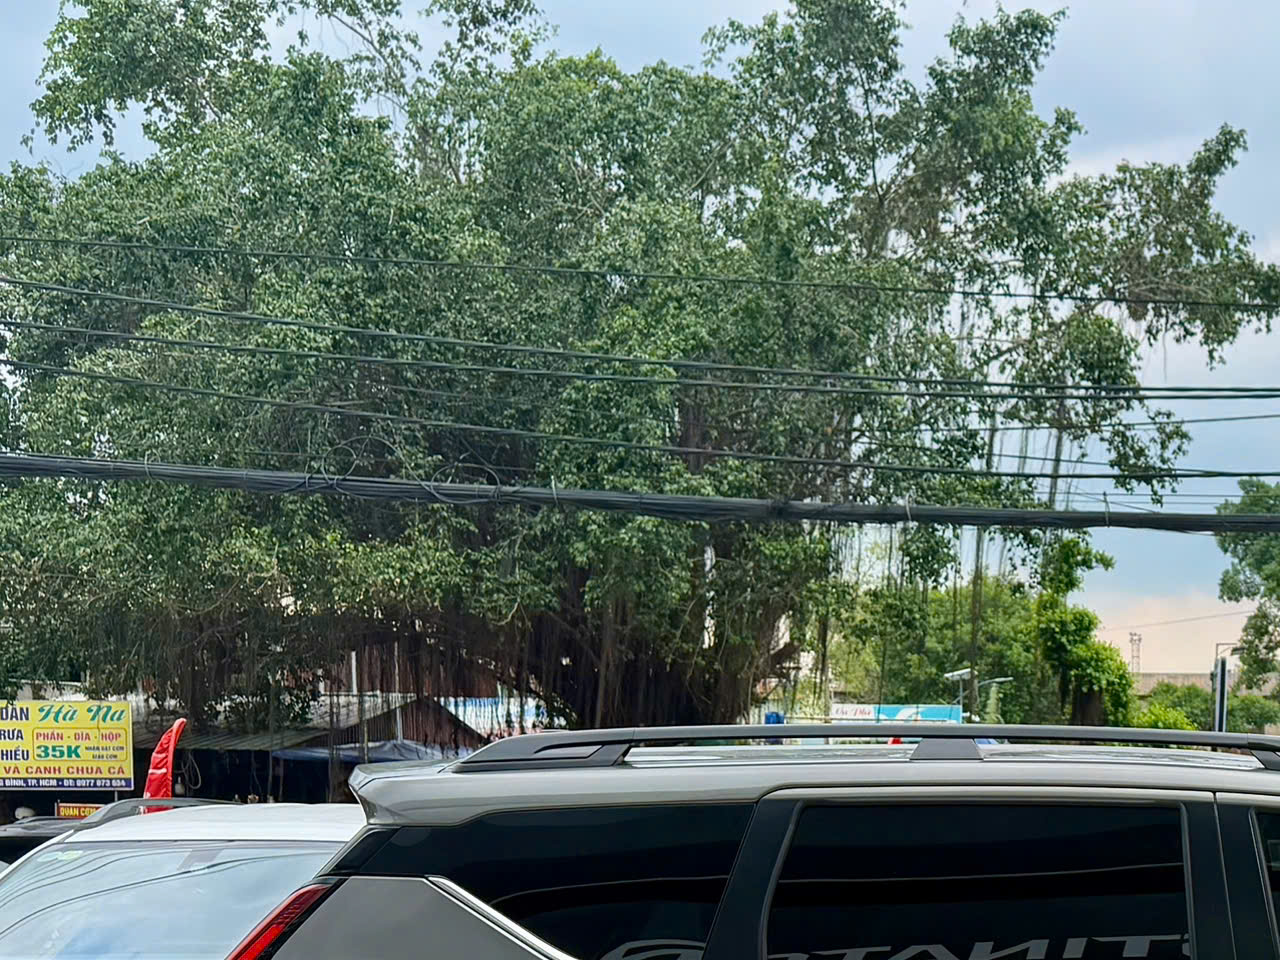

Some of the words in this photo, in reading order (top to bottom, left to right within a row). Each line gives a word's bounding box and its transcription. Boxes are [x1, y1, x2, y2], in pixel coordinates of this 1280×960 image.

[38, 704, 78, 723] Hà
[36, 744, 81, 759] 35K
[25, 766, 61, 775] CANH
[66, 766, 103, 775] CHUA
